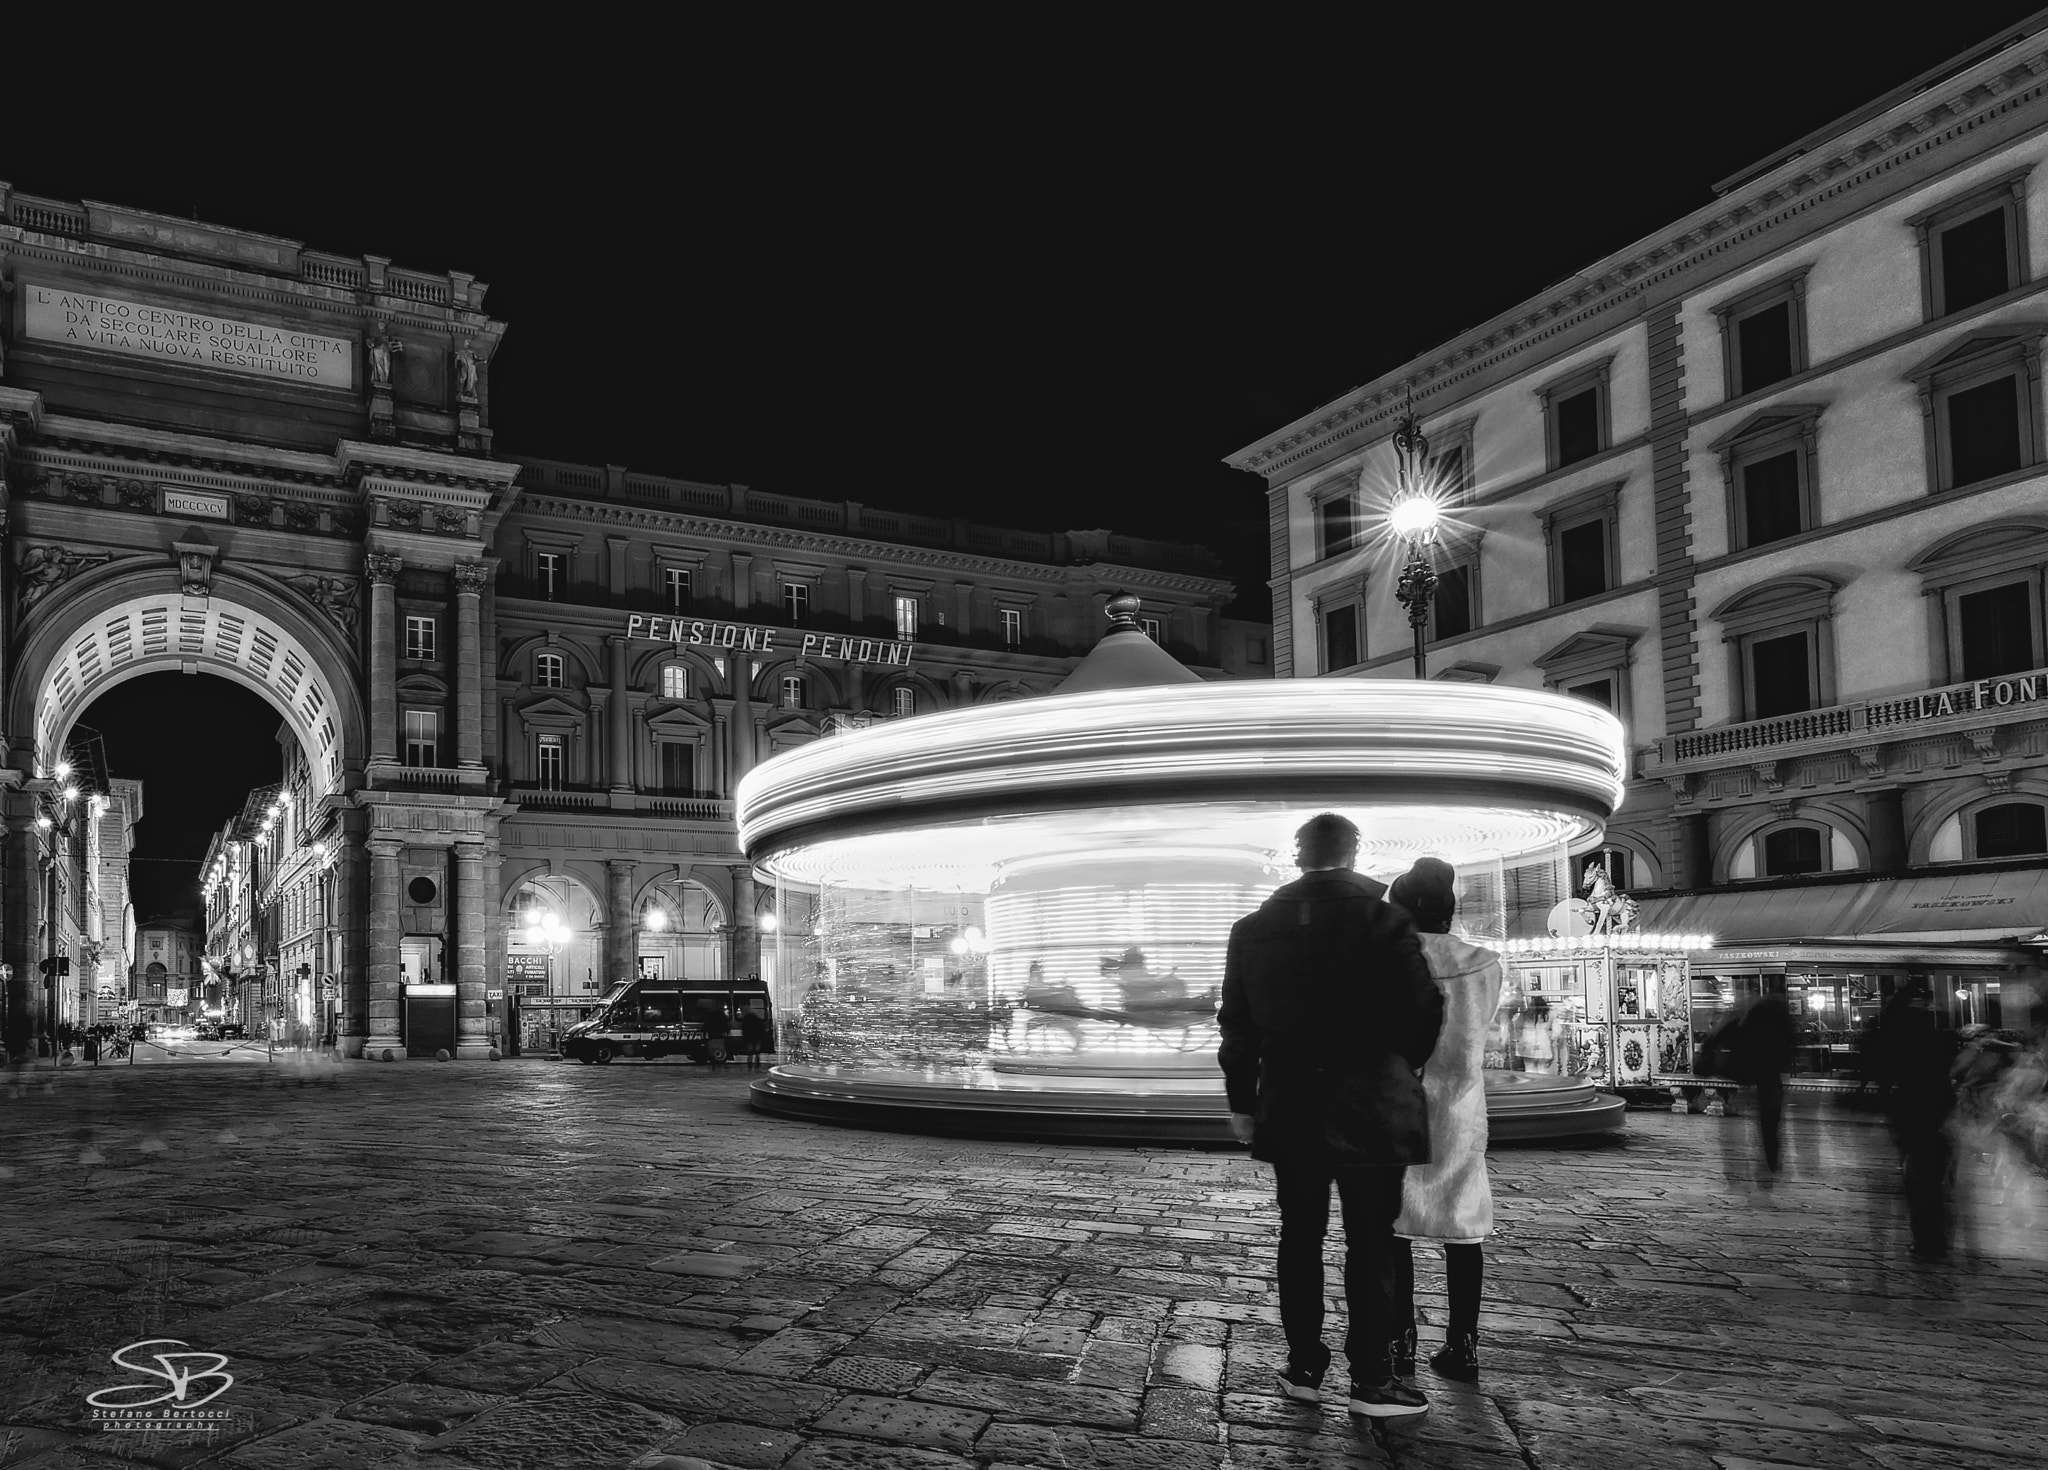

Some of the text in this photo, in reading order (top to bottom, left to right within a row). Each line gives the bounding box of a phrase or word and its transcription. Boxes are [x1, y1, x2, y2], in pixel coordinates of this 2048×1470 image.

[59, 296, 130, 317] ANTICO
[138, 309, 214, 332] CENTRO
[222, 323, 282, 344] DELLA
[66, 311, 318, 364] DA SECOLARE SQUALLORE
[66, 327, 318, 377] A VITA NUOVA RESTITUITO
[168, 498, 223, 513] MDCCCXCV
[627, 614, 913, 666] PENSIONE PENDINI
[1919, 673, 2048, 718] LA FON
[1718, 951, 1780, 959] PASZKOWSKI
[652, 1031, 702, 1041] POLIZIA
